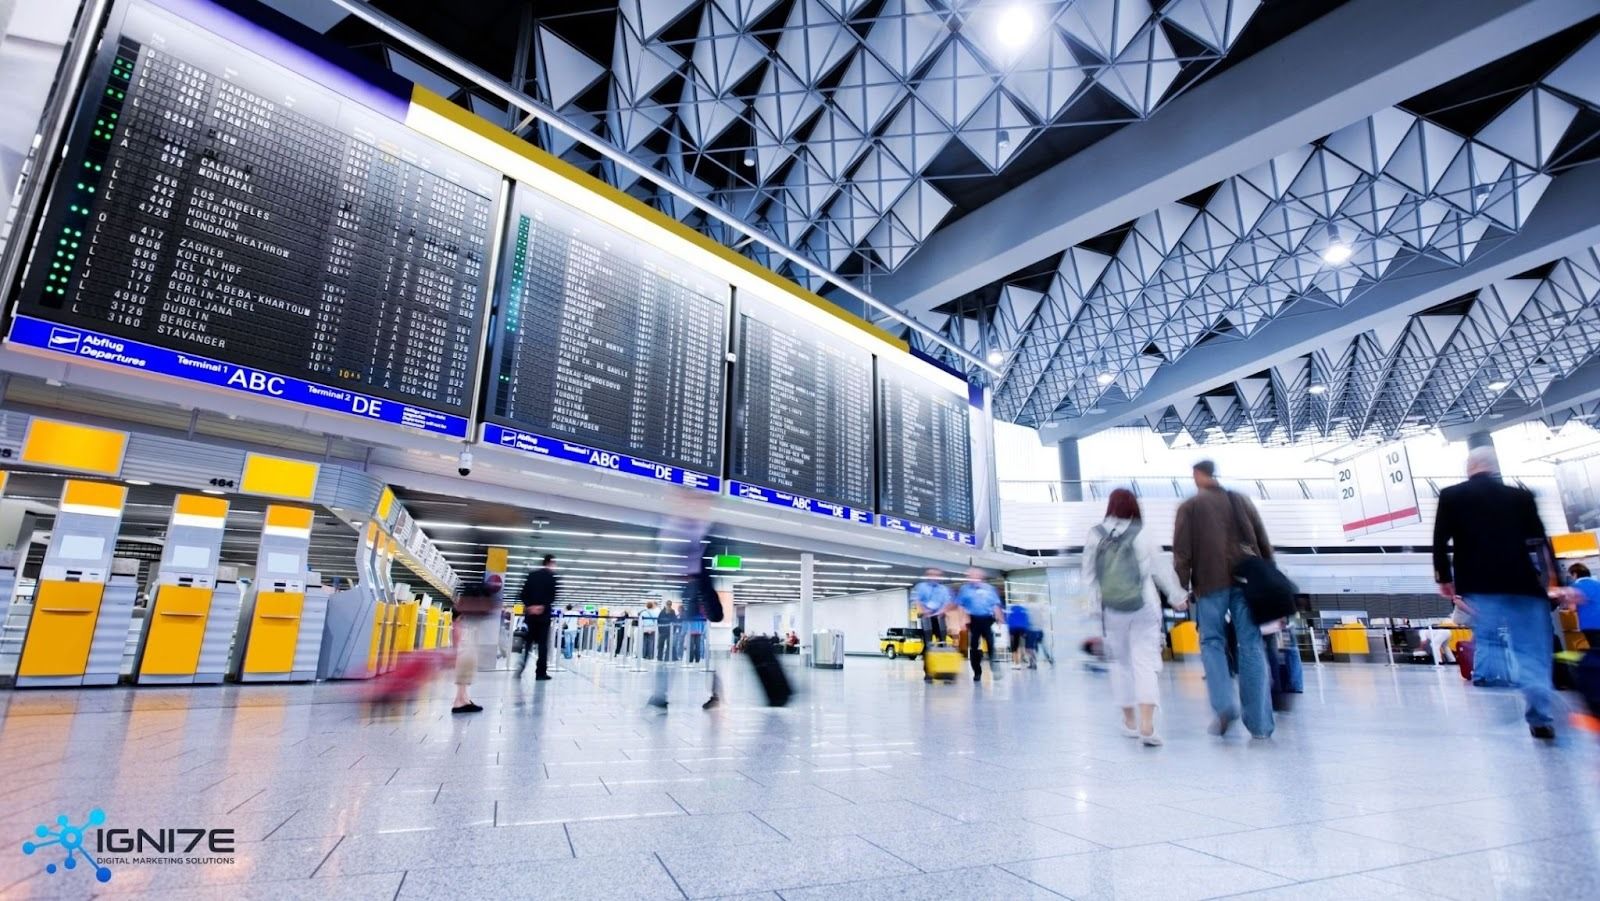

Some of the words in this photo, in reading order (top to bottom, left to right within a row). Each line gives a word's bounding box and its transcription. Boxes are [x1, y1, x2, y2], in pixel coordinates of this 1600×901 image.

[132, 98, 141, 107] L
[138, 79, 146, 87] L
[212, 110, 248, 130] MIAMI
[141, 69, 149, 78] L
[214, 101, 270, 129] PORTLAND
[144, 60, 152, 68] L
[217, 91, 272, 120] HELSINKI
[219, 82, 274, 111] VARADERO
[120, 138, 129, 147] A
[161, 153, 184, 167] 875
[197, 167, 254, 193] MONTREAL
[123, 128, 132, 137] L
[200, 157, 249, 181] CALGARY
[108, 180, 116, 188] L
[149, 194, 173, 207] 440
[187, 207, 238, 229] HOUSTON
[111, 169, 119, 178] L
[152, 183, 176, 197] 442
[189, 197, 240, 220] DETROIT
[114, 159, 123, 168] L
[155, 173, 178, 187] 456
[192, 187, 214, 200] LOS
[221, 197, 269, 219] ANGELES
[98, 212, 107, 221] O
[140, 225, 164, 239] 417
[179, 237, 224, 257] ZAGREB
[104, 190, 113, 199] L
[184, 217, 289, 257] LONDON-HEATHROW
[91, 234, 100, 243] L
[134, 247, 159, 260] 686
[173, 258, 197, 271] TEL
[204, 267, 233, 282] AVIV
[95, 223, 104, 232] L
[129, 233, 162, 249] 6808
[221, 261, 242, 274] HBF
[77, 279, 87, 288] L
[113, 289, 147, 304] 4980
[162, 302, 209, 320] DUBLIN
[81, 268, 90, 277] J
[125, 280, 150, 293] 117
[165, 291, 233, 315] LJUBLJANA
[84, 256, 94, 265] L
[128, 269, 153, 282] 176
[168, 280, 256, 311] BERLIN-TEGEL
[88, 245, 97, 254] L
[131, 258, 156, 271] 590
[170, 269, 209, 286] ADDIS
[216, 282, 311, 315] ABEBA-KHARTOUM
[70, 303, 80, 312] L
[107, 312, 141, 327] 3160
[156, 324, 226, 348] STAVANGER
[74, 291, 83, 300] L
[159, 313, 206, 331] BERGEN
[80, 346, 146, 367] Departures
[83, 335, 124, 352] Abflug
[177, 355, 222, 373] Terminal
[227, 369, 286, 395] ABC
[307, 385, 344, 400] Terminal
[352, 396, 383, 417] DE
[589, 451, 620, 469] ABC
[655, 465, 673, 481] DE
[1338, 468, 1352, 482] 20
[1386, 451, 1400, 465] 10
[1389, 470, 1404, 484] 10
[210, 478, 234, 488] 464
[792, 497, 811, 510] ABC
[1342, 487, 1355, 500] 20
[832, 505, 844, 518] DE
